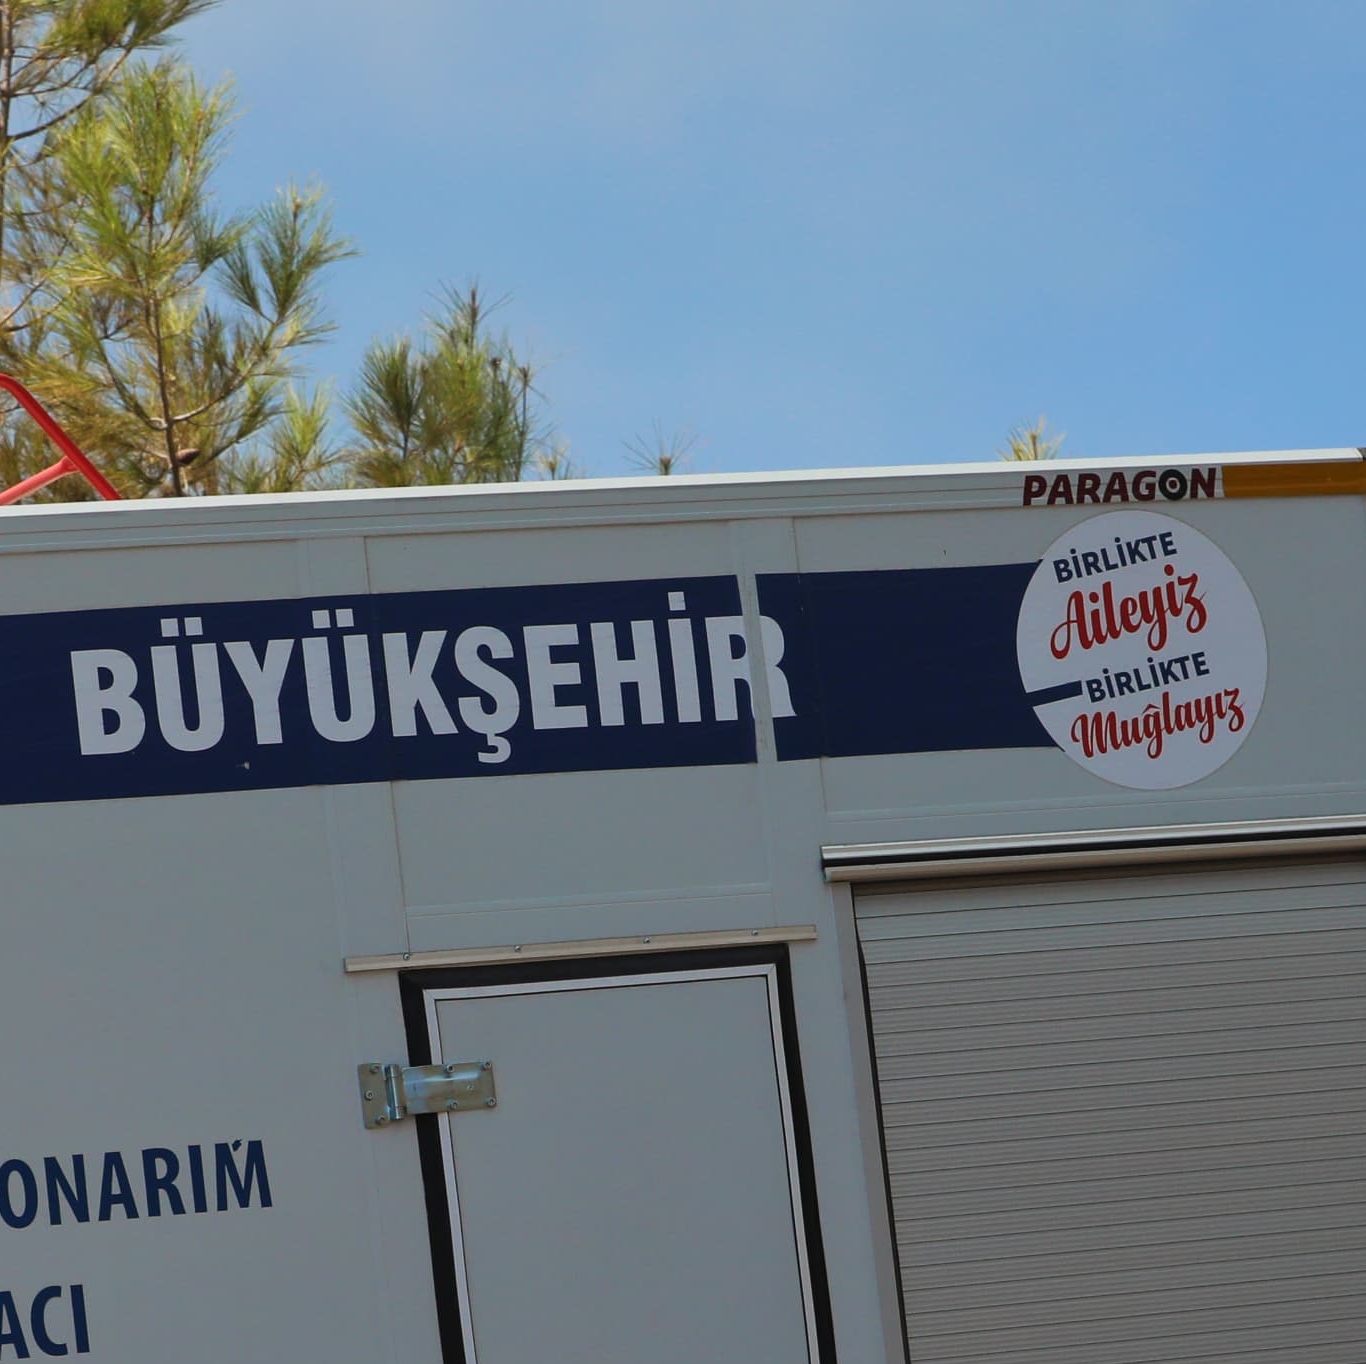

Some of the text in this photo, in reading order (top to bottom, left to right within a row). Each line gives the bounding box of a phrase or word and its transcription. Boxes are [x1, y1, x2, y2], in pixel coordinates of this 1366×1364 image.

[1022, 467, 1217, 506] PARAGON
[1053, 531, 1177, 583] BİRLİKTE
[1050, 564, 1208, 660] Aileyiz
[70, 591, 797, 764] BÜYÜKŞEHİR
[1085, 651, 1210, 703] BİRLİKTE
